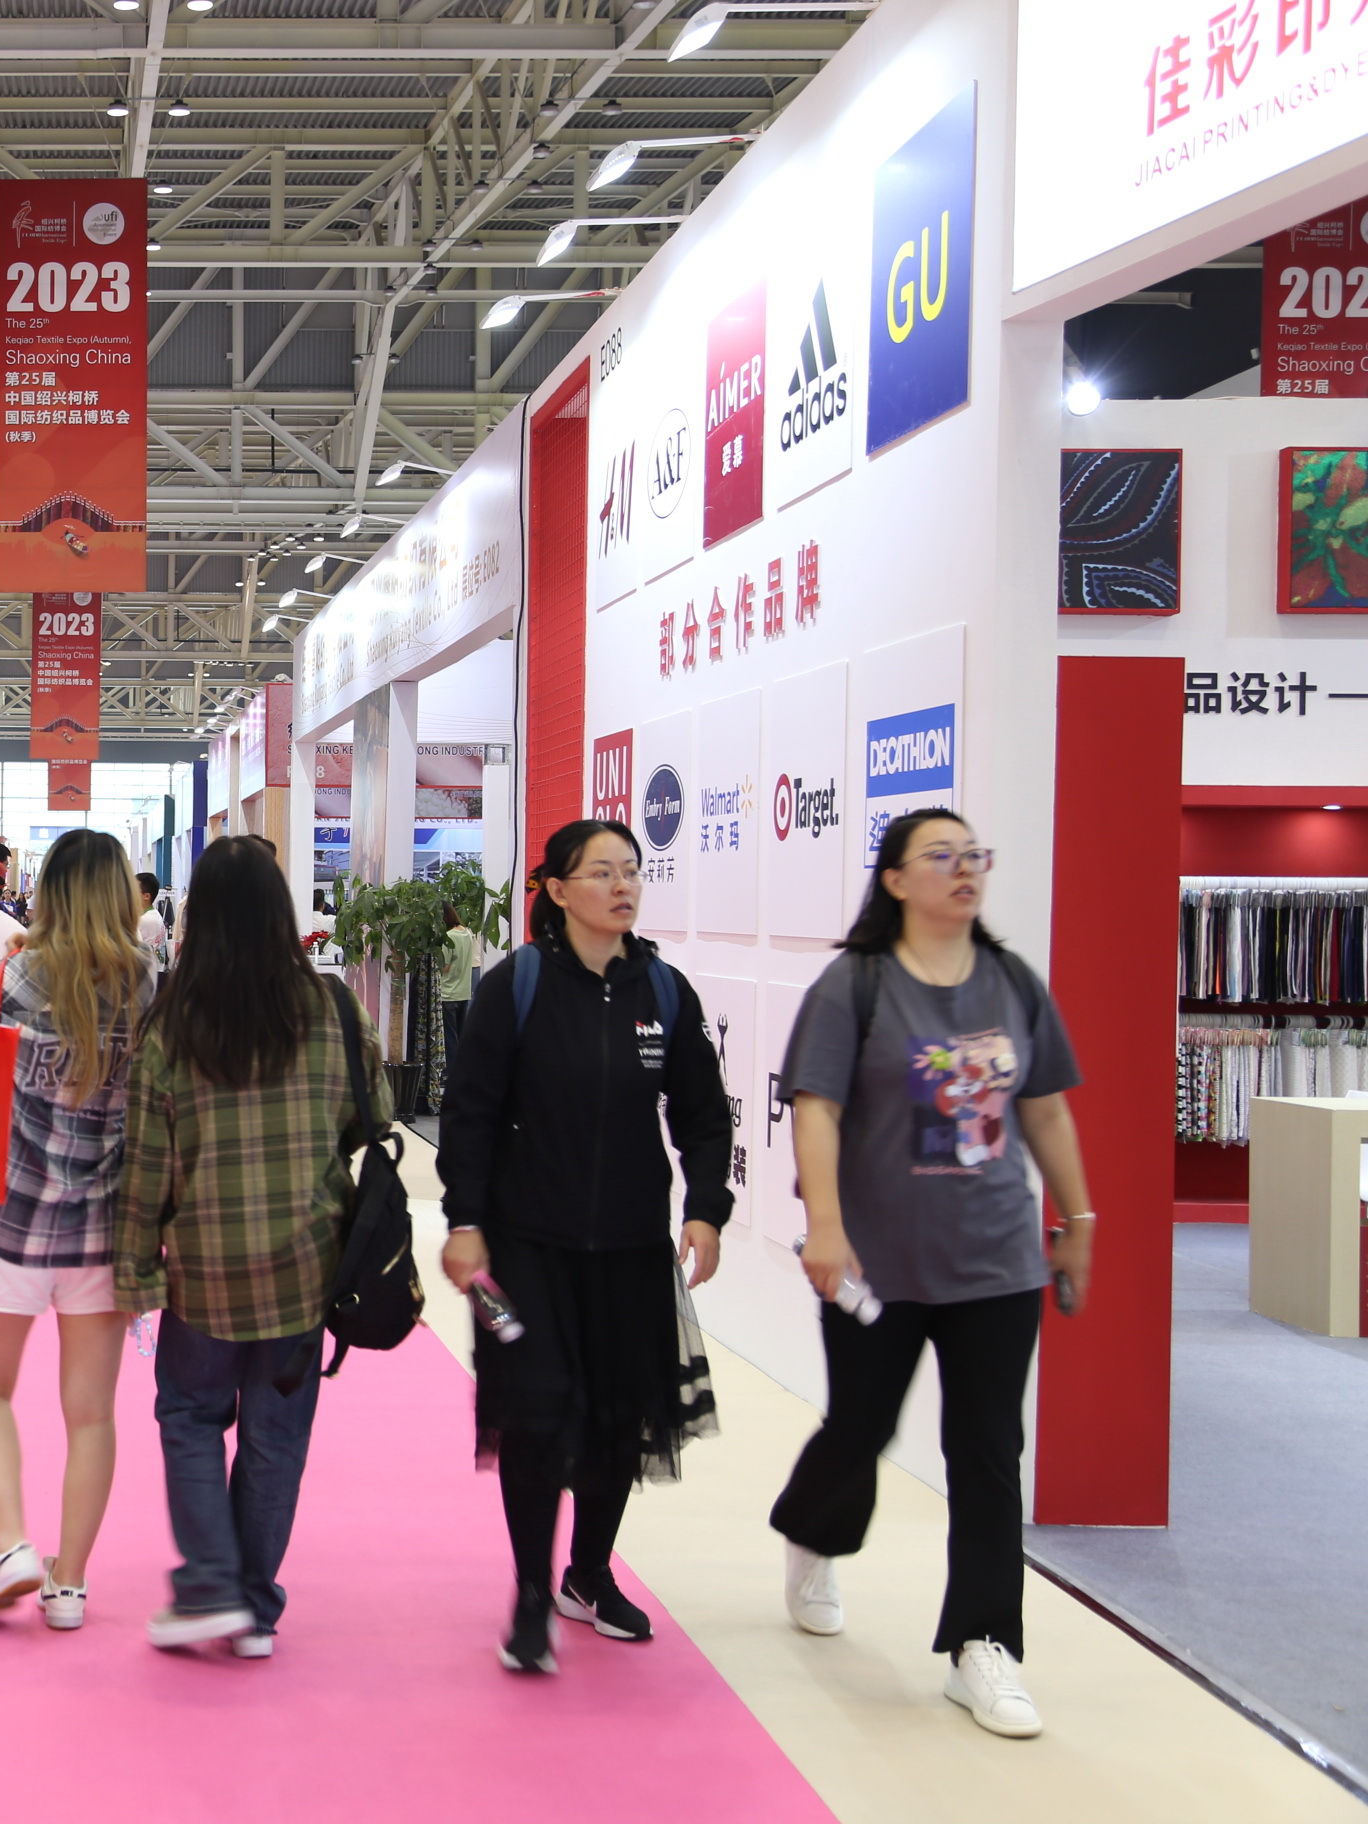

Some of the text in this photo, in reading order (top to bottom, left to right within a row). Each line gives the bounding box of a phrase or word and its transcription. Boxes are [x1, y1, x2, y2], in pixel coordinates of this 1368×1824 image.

[1134, 136, 1196, 188] JIACAI
[6, 261, 131, 313] 2023
[886, 210, 949, 343] GU
[5, 318, 50, 329] The 25th
[1278, 323, 1324, 335] The 25th
[5, 335, 34, 345] Keqiao
[36, 335, 64, 344] Textile
[66, 335, 88, 346] Expo
[1277, 342, 1363, 352] Keqiao Textile Expo
[6, 349, 131, 367] Shaoxing China
[600, 326, 623, 383] E088
[1277, 356, 1354, 375] Shaoxing
[5, 371, 56, 386] 第25届
[1276, 379, 1329, 394] 第25届
[5, 390, 99, 406] 中国绍兴柯桥
[5, 409, 130, 425] 国际纺织品博览会
[780, 371, 847, 452] adidas
[5, 430, 36, 443] (秋季)
[651, 426, 687, 500] A&F
[721, 434, 744, 477] 爱慕
[659, 539, 820, 678] 部分合作品牌
[38, 612, 95, 636] 2023
[38, 651, 94, 660] Shaoxing China
[869, 726, 950, 778] DECATHLON
[596, 745, 628, 801] UNI
[644, 798, 663, 821] Embry
[663, 796, 681, 816] Form
[700, 783, 740, 818] Walmart
[700, 820, 739, 852] 沃尔玛
[647, 856, 675, 884] 安莉芳
